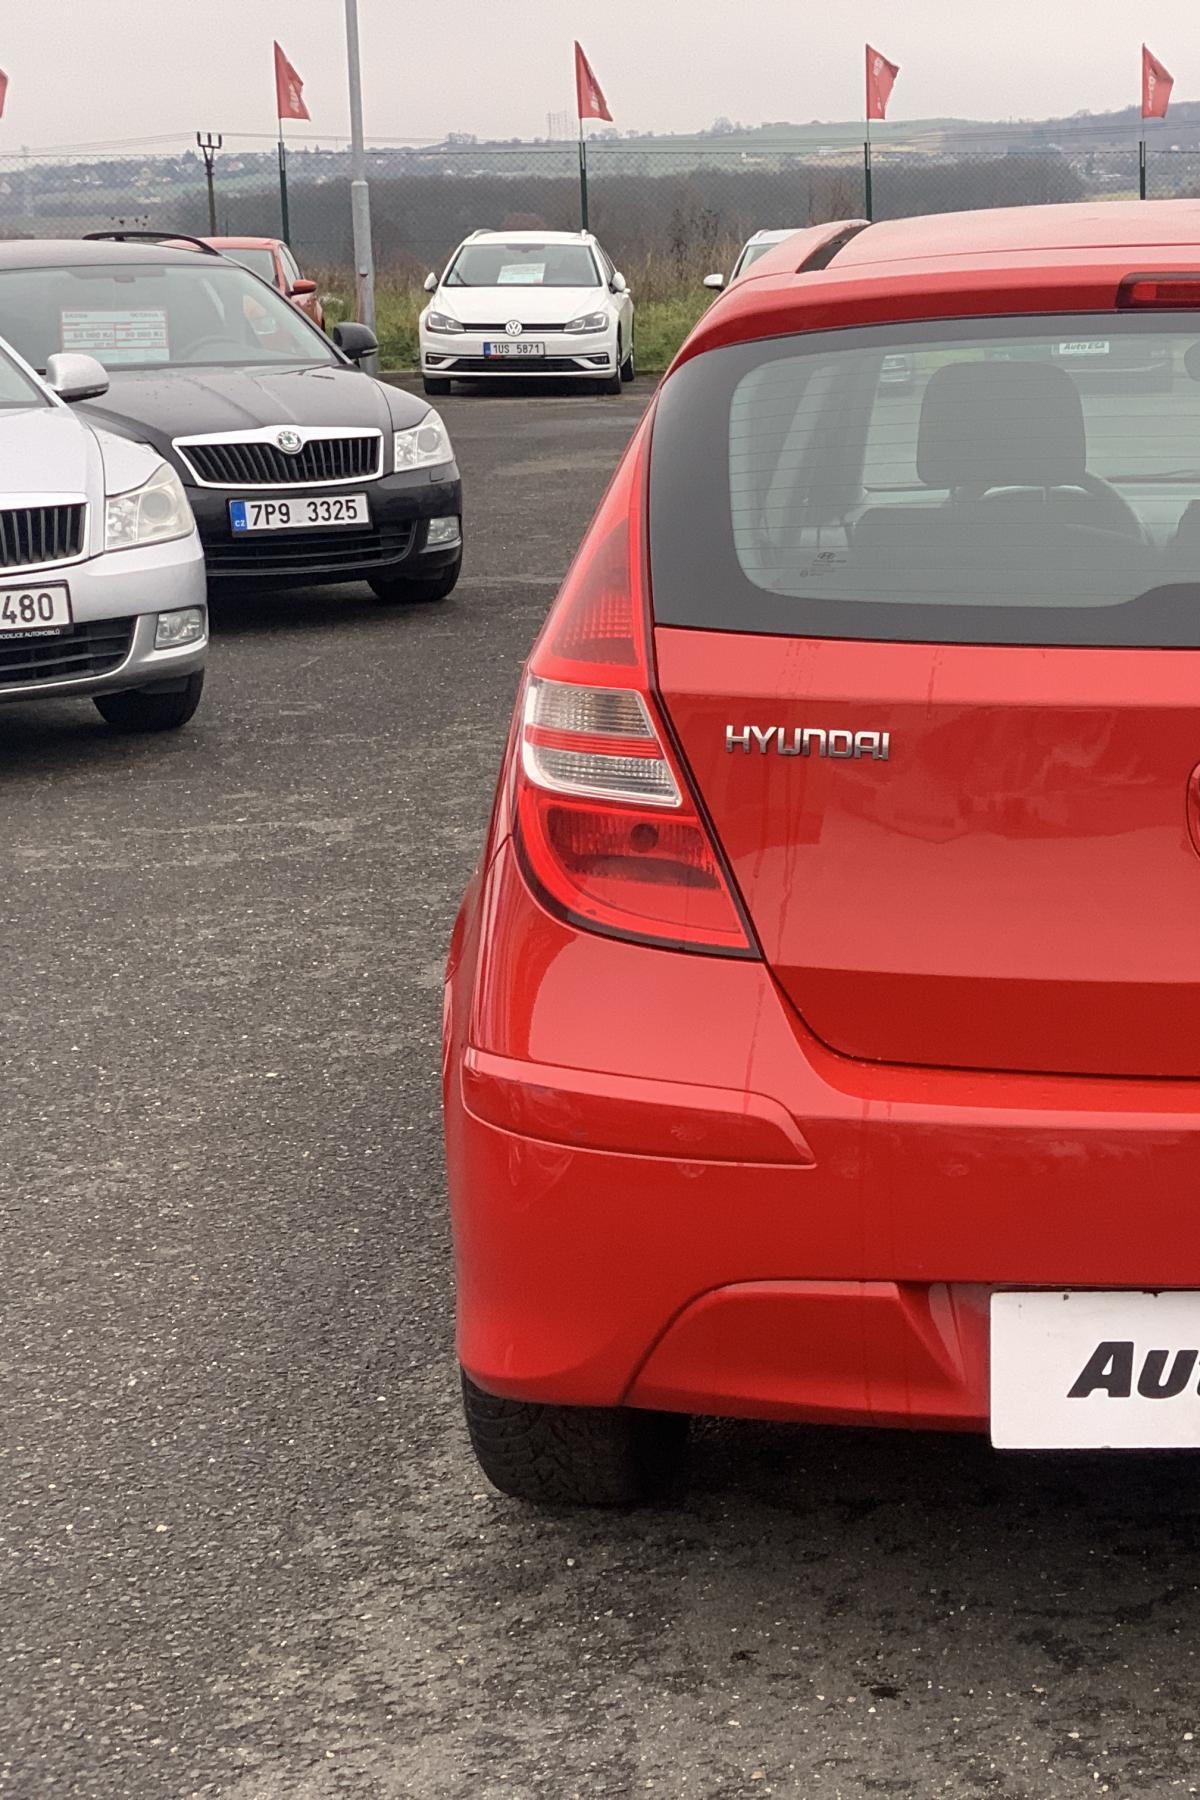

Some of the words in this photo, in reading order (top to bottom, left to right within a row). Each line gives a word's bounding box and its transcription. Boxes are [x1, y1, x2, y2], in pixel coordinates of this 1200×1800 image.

[493, 344, 510, 353] 1US
[516, 344, 540, 353] 5871
[250, 503, 290, 526] 7P9
[307, 499, 358, 522] 3325
[726, 725, 890, 760] HYUNDAI
